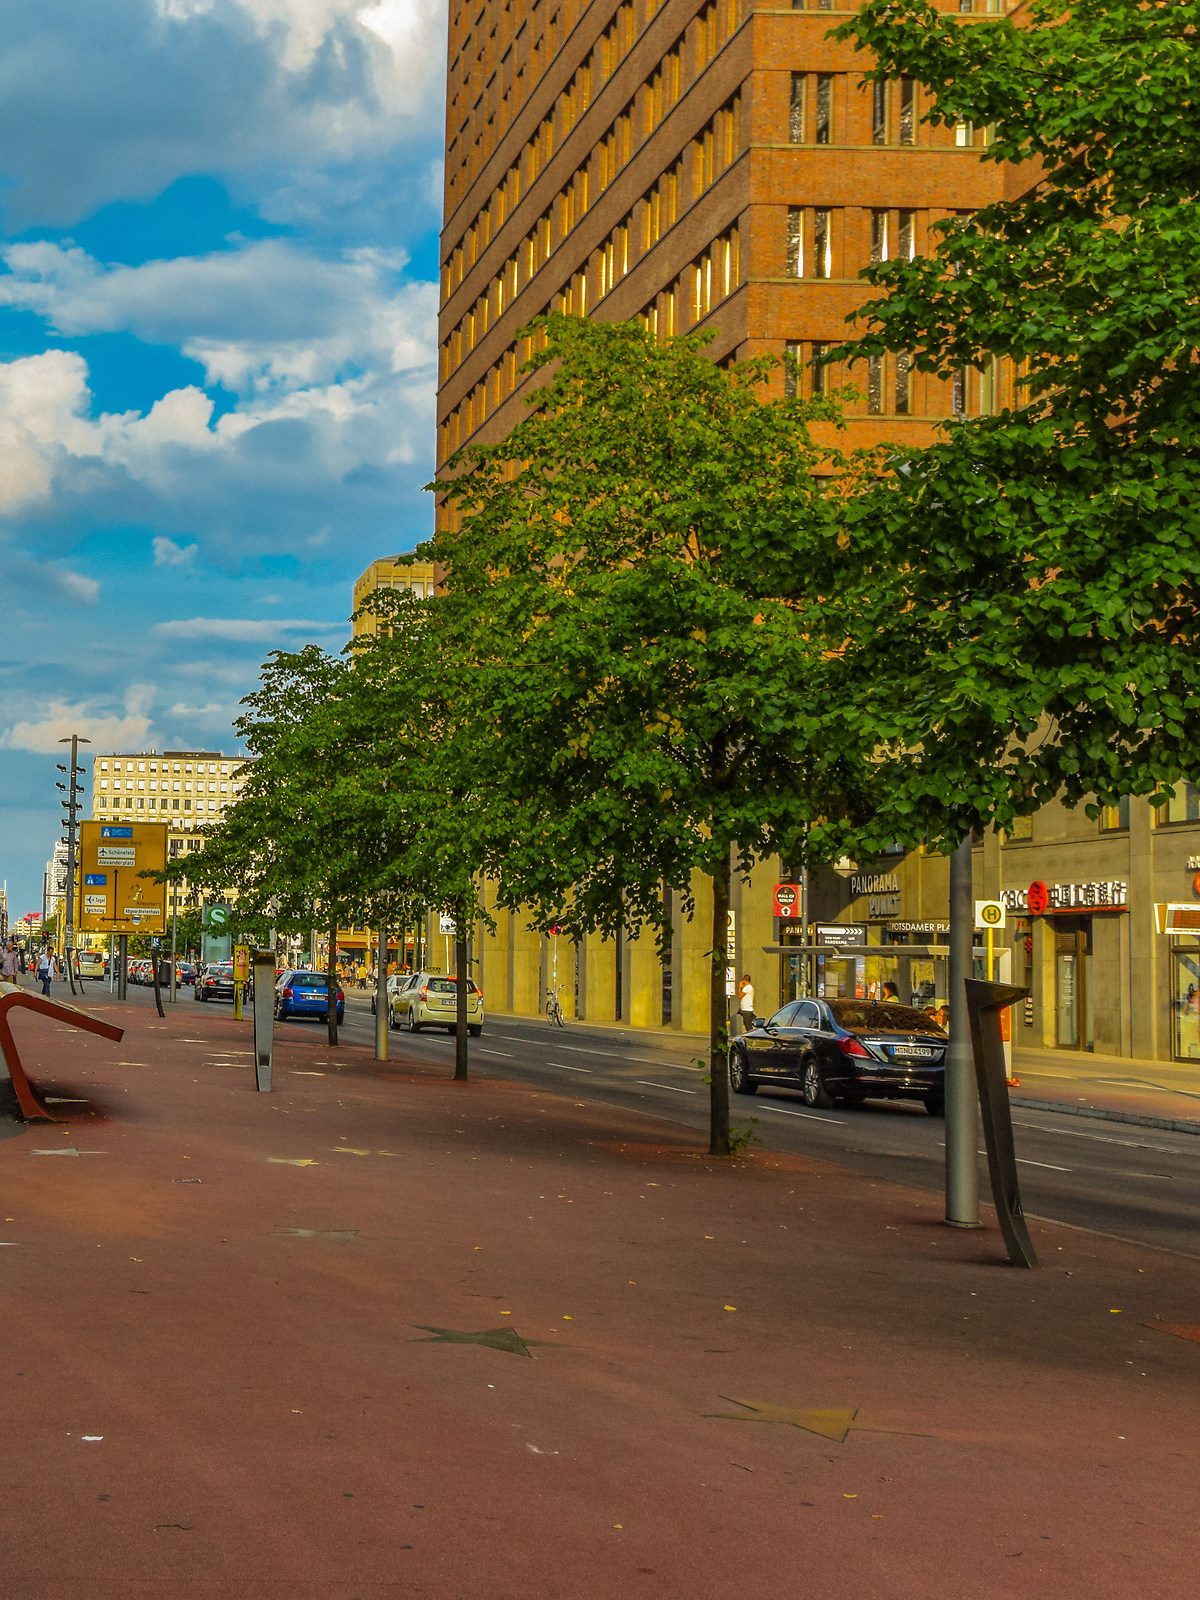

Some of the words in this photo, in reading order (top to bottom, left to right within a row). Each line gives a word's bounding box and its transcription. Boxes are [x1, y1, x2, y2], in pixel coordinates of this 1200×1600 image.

[851, 874, 898, 893] PANORAMA
[869, 896, 900, 915] PUNKT
[987, 909, 997, 920] H
[891, 922, 935, 932] POTSDAMER
[936, 923, 951, 932] PLA
